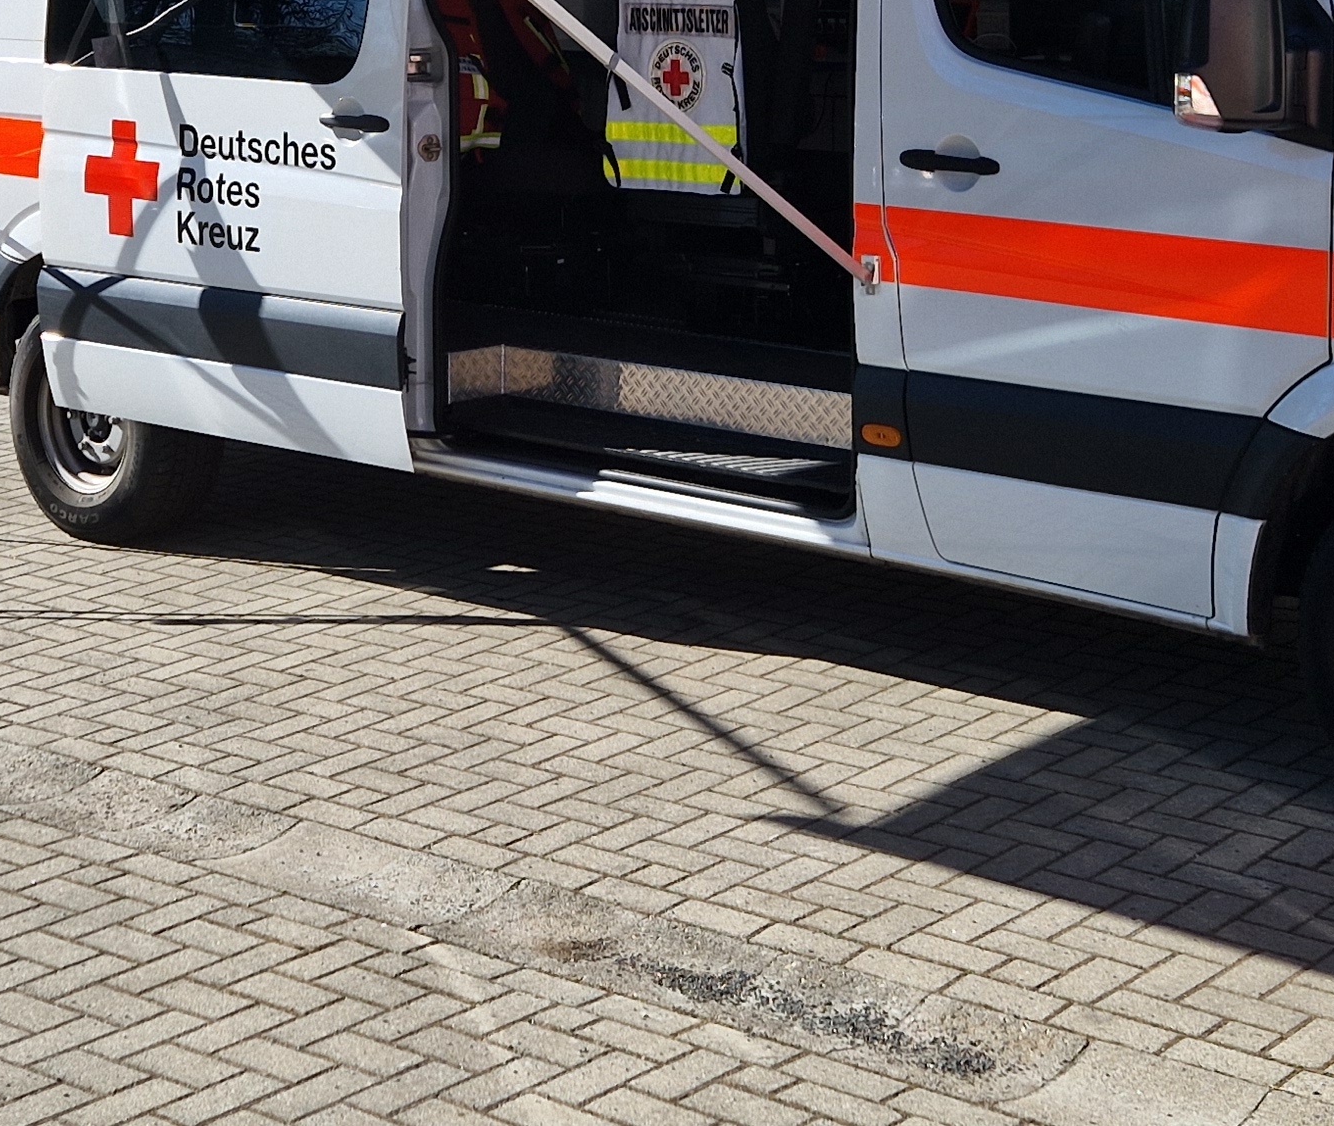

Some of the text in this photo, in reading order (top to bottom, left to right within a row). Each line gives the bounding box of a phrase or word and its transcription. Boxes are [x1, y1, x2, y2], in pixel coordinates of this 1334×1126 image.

[654, 45, 700, 73] DEUTSCHES
[179, 124, 336, 170] Deutsches
[177, 167, 260, 208] Rotes
[177, 210, 260, 252] Kreuz
